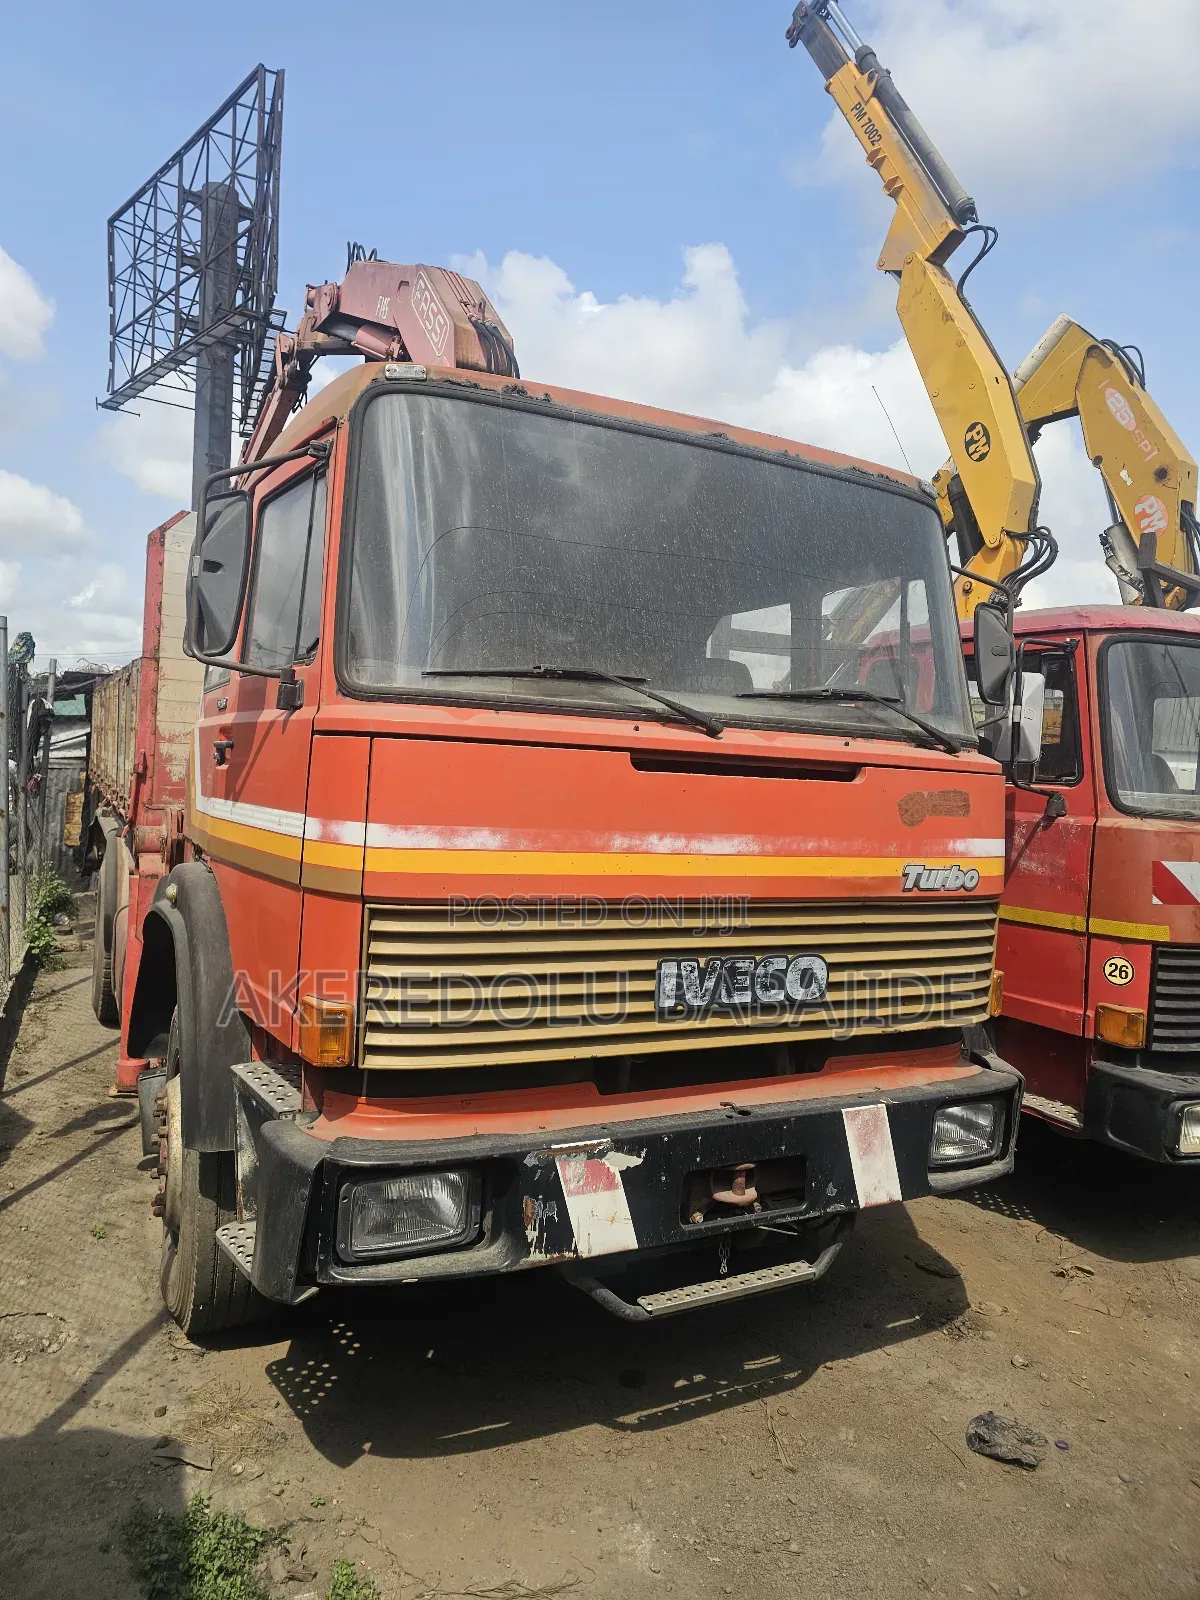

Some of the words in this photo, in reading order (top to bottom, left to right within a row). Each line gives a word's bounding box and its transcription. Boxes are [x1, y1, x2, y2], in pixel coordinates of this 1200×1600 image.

[851, 101, 867, 122] PM
[861, 117, 883, 146] 7002
[414, 279, 447, 348] FASSI
[1106, 392, 1135, 425] 25
[965, 423, 990, 461] PM
[1134, 495, 1168, 533] PM
[902, 864, 979, 892] Turbo
[655, 953, 829, 1012] IVECO
[1108, 962, 1129, 980] 26
